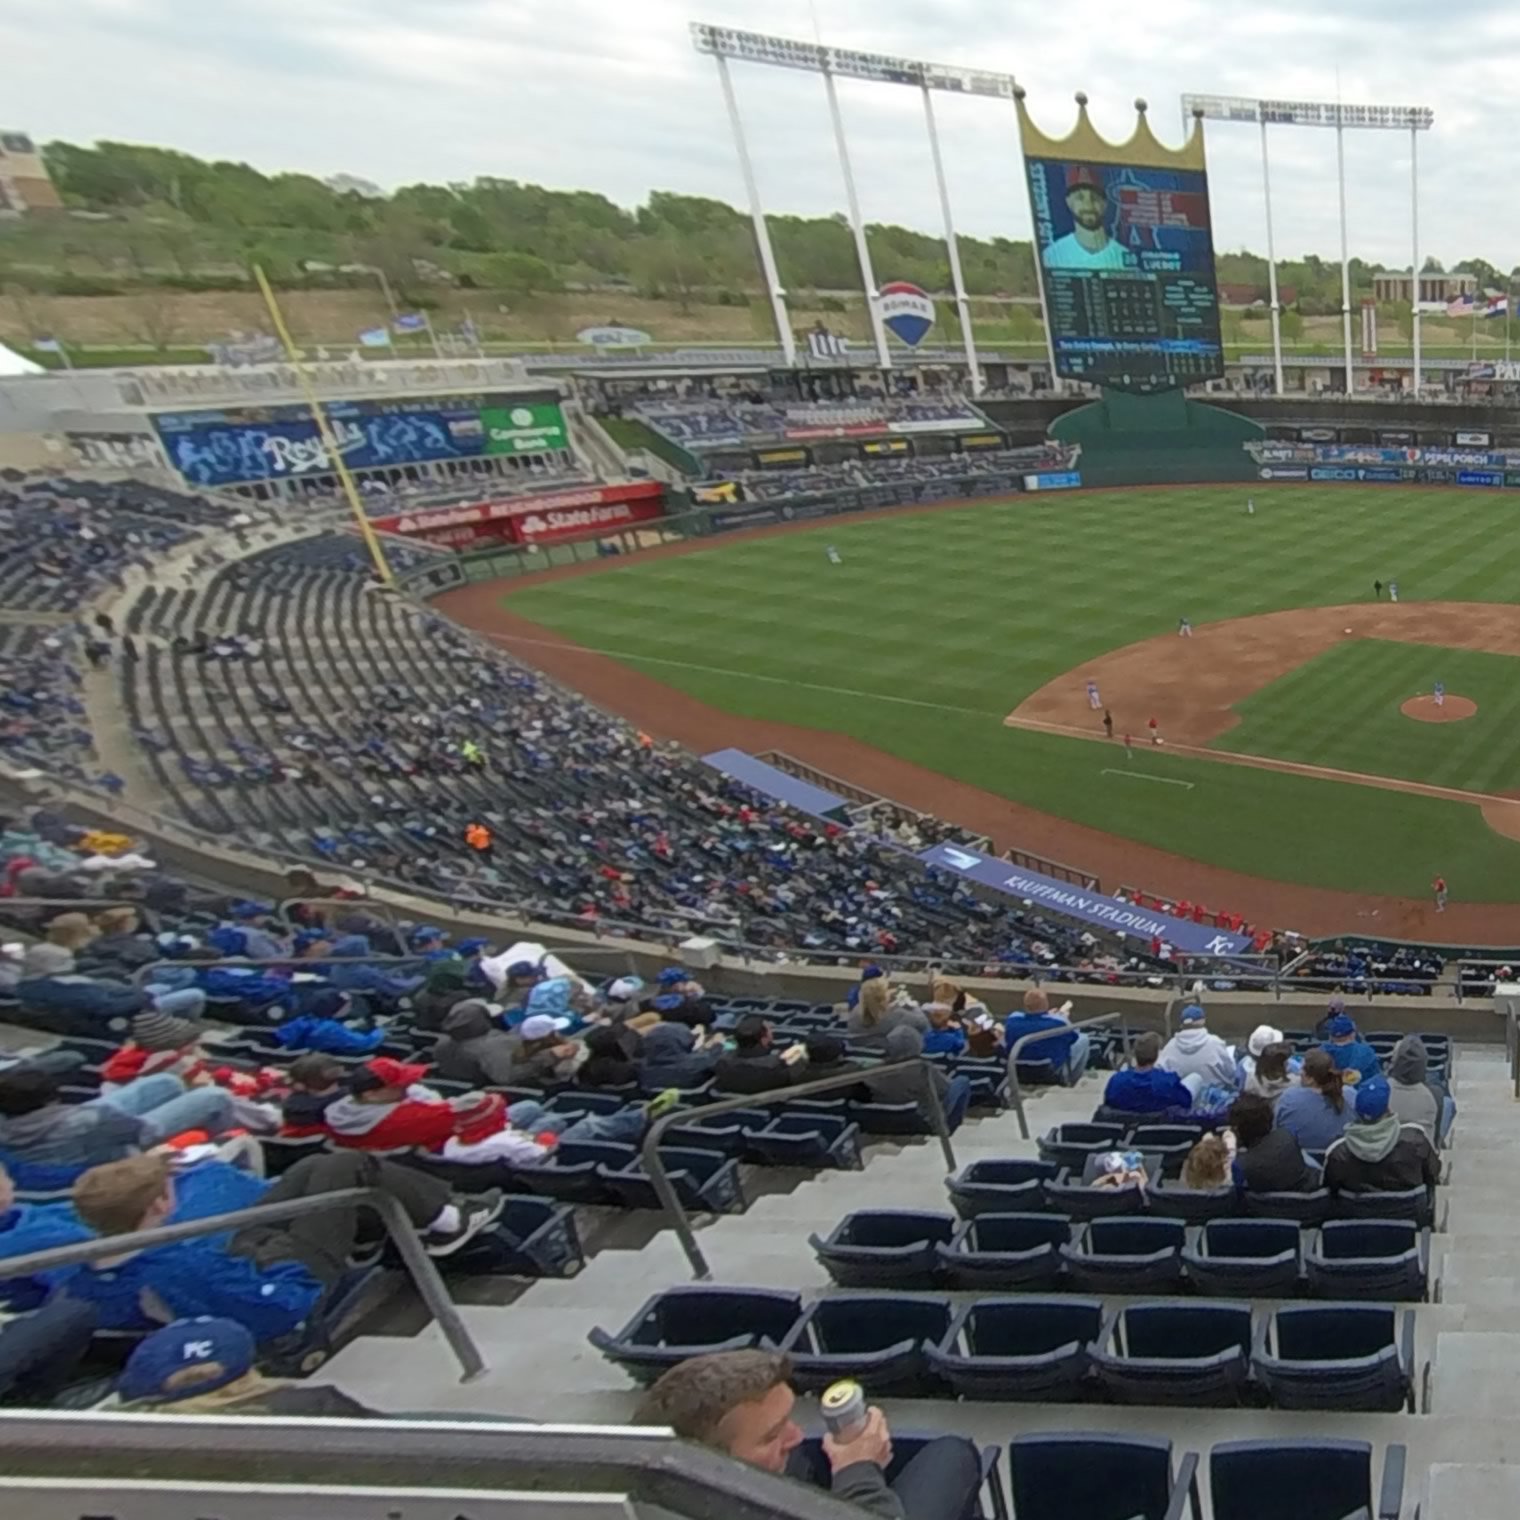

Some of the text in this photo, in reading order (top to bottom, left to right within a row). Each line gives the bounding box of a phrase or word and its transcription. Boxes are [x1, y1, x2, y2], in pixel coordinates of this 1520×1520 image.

[1311, 468, 1356, 480] GEICO
[1003, 875, 1165, 937] KAUFFMAN STADIUM
